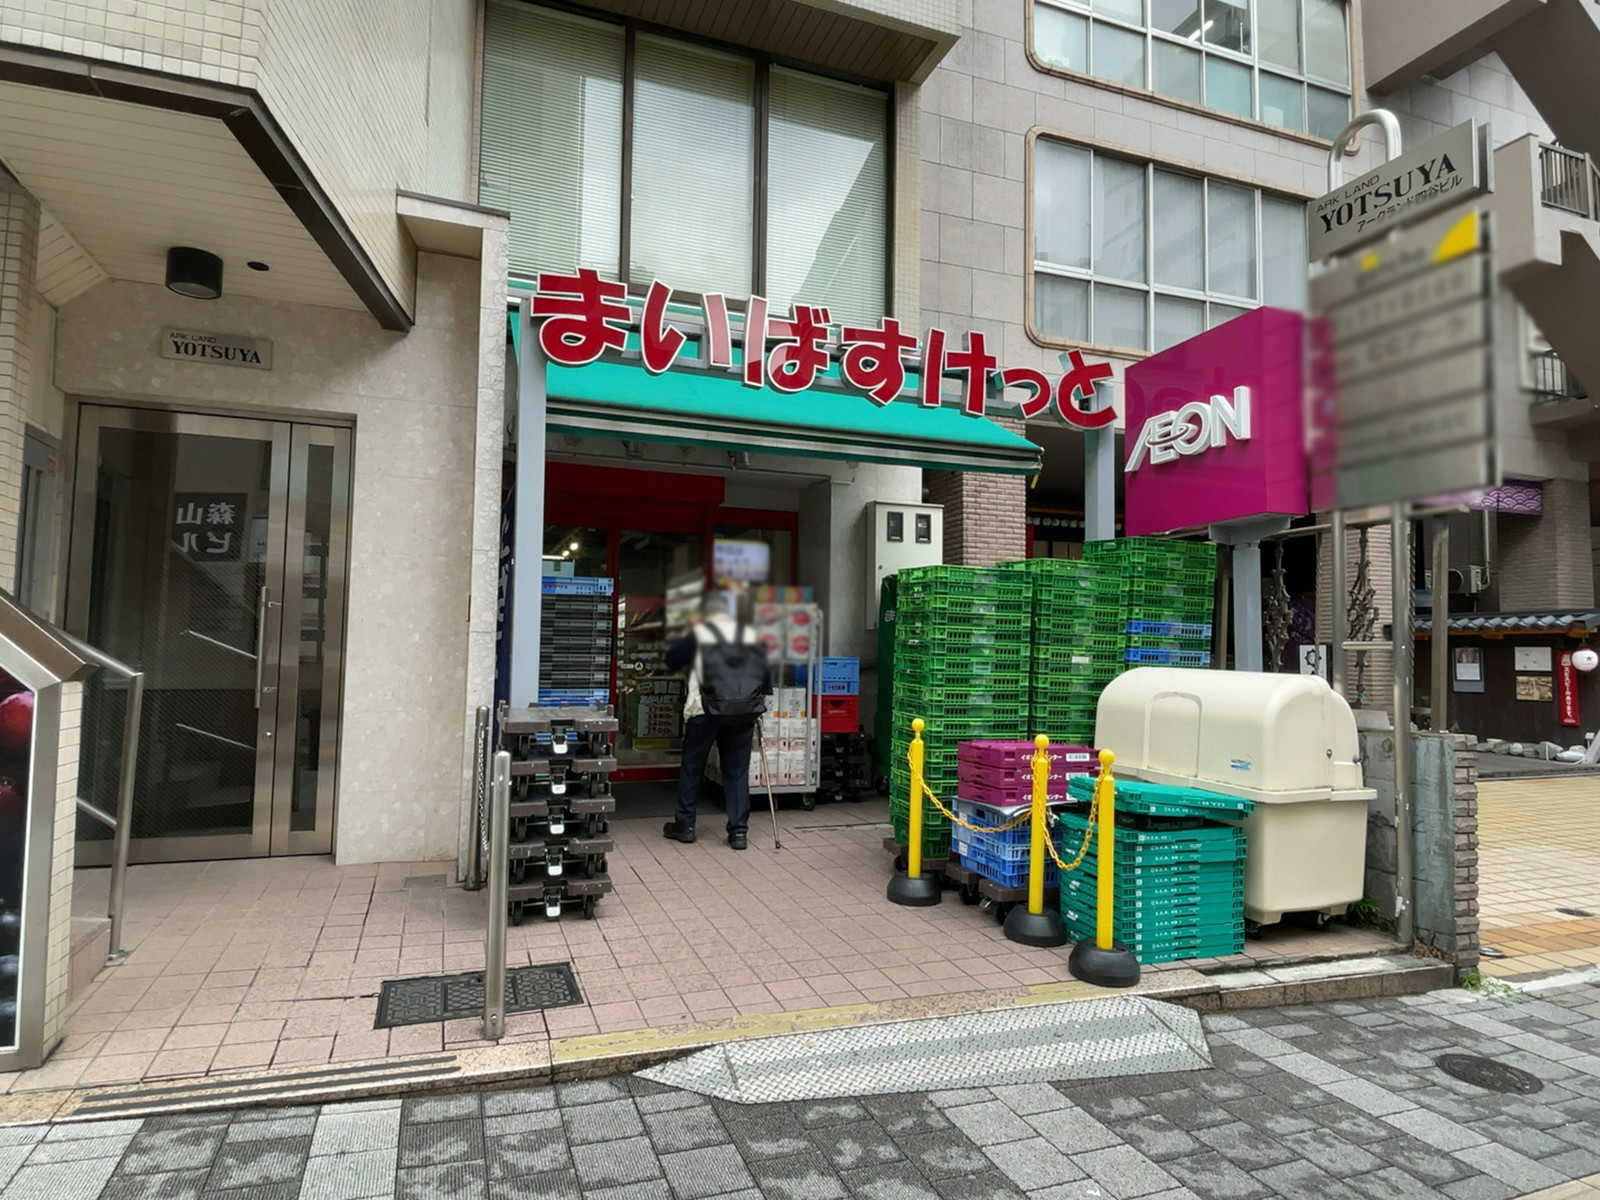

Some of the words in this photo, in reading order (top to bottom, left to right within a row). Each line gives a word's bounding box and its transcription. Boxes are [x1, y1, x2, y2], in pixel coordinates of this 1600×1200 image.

[1316, 194, 1340, 214] ARK
[1345, 175, 1380, 198] LAND
[1320, 153, 1457, 234] YOTSUYA
[171, 340, 262, 364] YOTSUYA
[192, 335, 217, 344] LAND
[530, 267, 1118, 429] まいばすけっと
[1124, 385, 1251, 473] AEON
